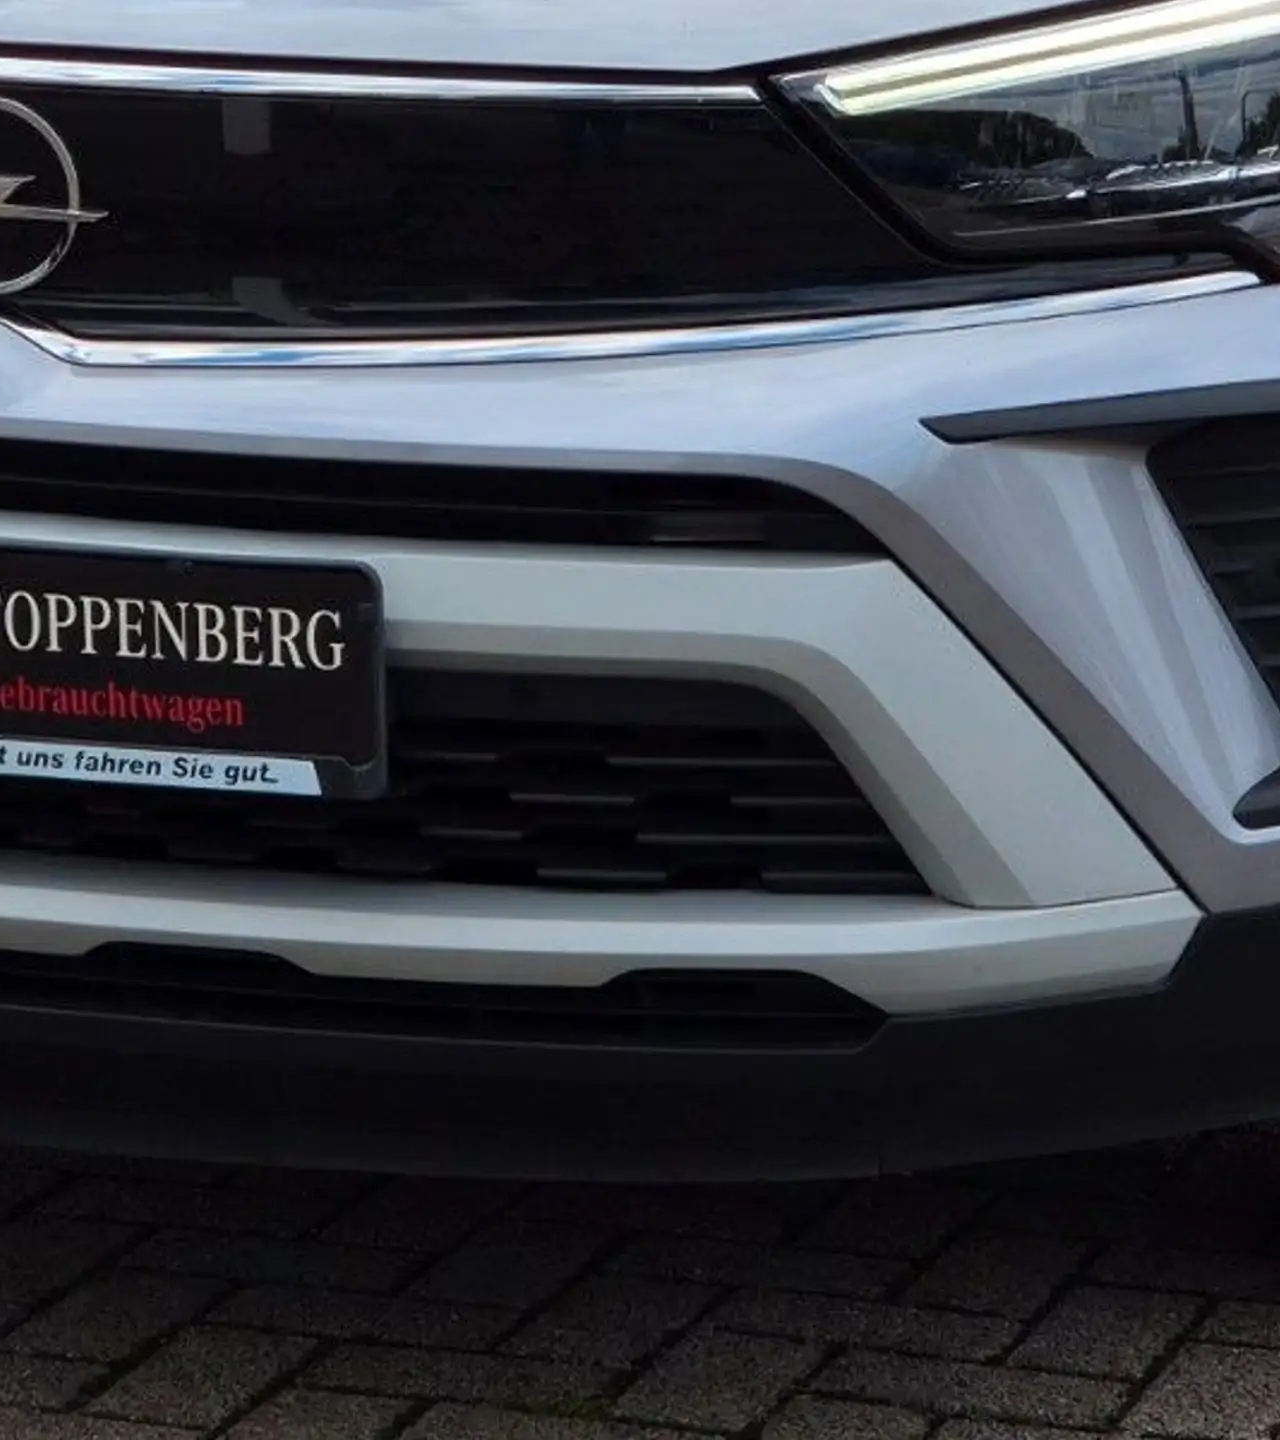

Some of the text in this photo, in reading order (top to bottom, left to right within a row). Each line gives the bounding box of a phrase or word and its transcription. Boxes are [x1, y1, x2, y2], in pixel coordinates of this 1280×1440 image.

[17, 751, 64, 770] uns
[73, 750, 162, 778] fahren
[171, 757, 212, 780] Sie
